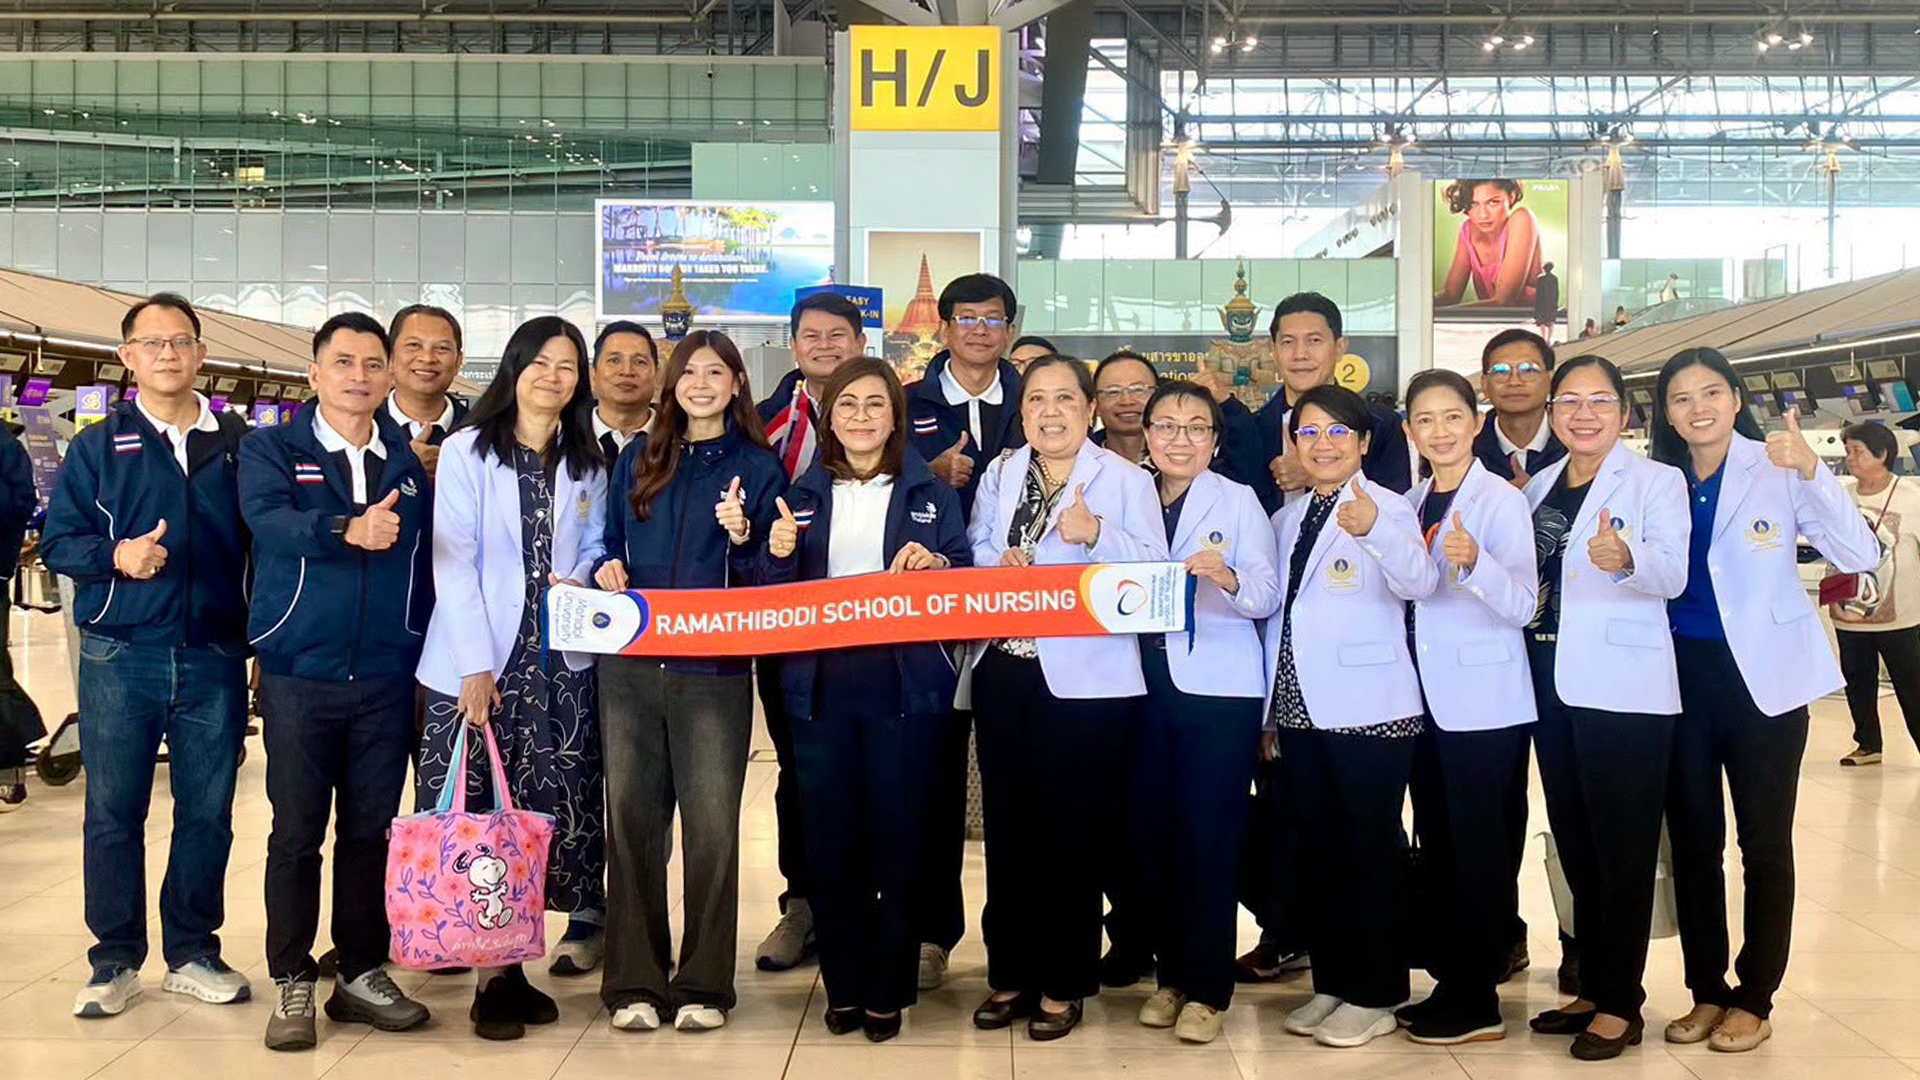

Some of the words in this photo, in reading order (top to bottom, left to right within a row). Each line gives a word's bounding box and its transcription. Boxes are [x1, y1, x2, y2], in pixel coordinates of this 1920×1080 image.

[860, 49, 990, 108] H/J
[1342, 363, 1356, 383] 2
[560, 591, 576, 644] University
[656, 604, 818, 636] RAMATHIBODI
[822, 595, 922, 625] SCHOOL
[926, 593, 959, 616] OF
[964, 588, 1077, 615] NURSING
